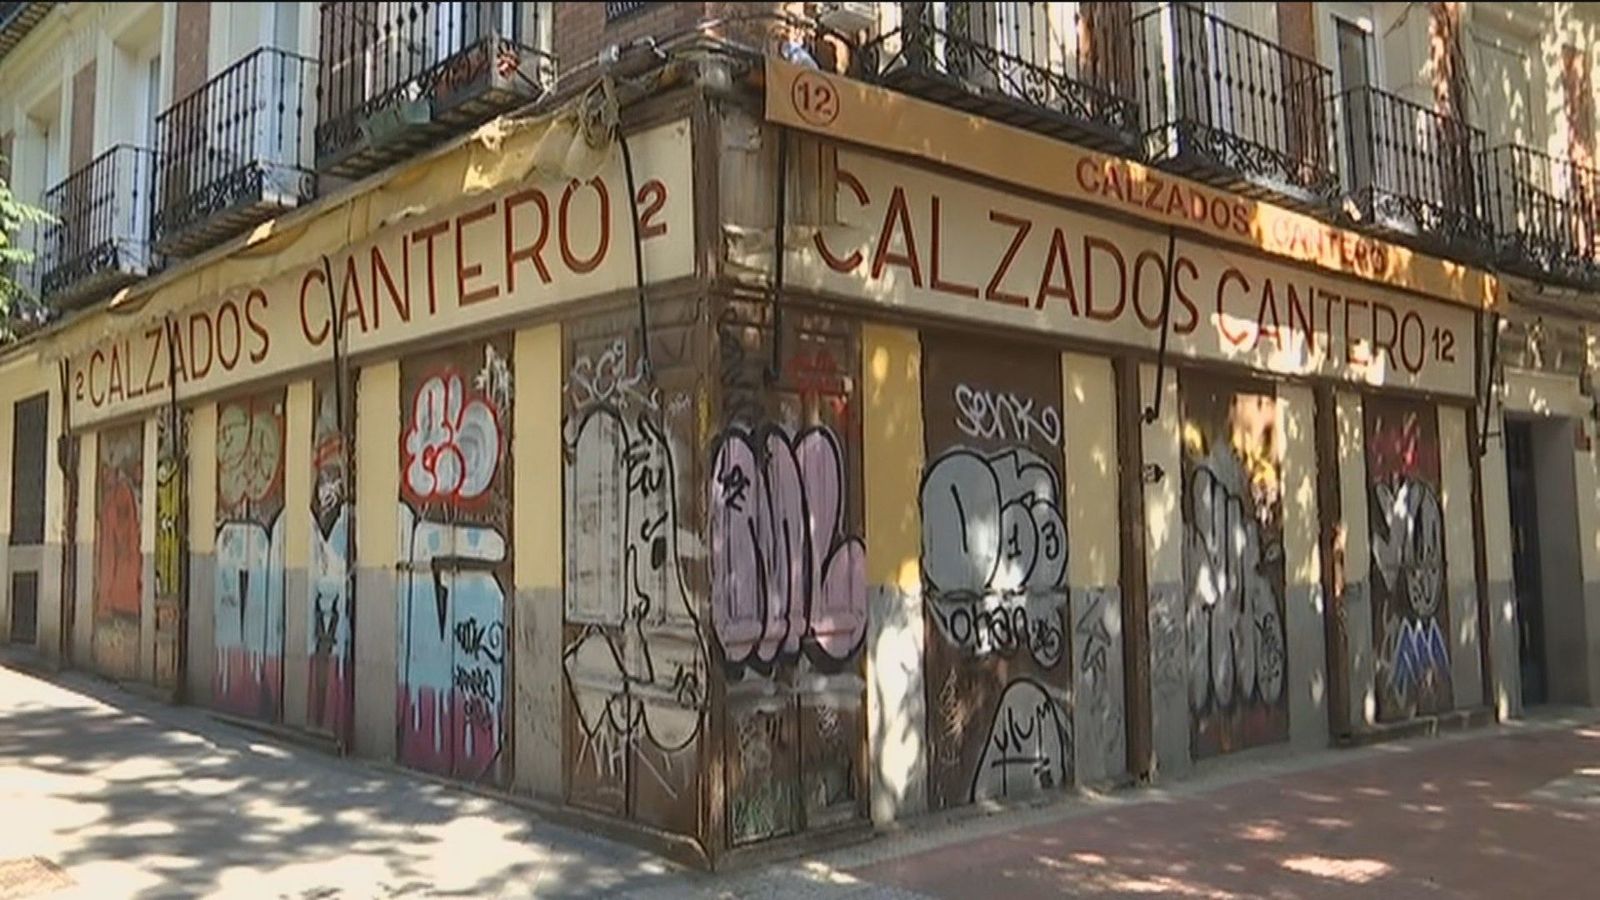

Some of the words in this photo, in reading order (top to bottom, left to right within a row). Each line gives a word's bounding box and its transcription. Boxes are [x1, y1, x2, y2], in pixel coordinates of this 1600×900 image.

[796, 83, 833, 116] 12
[76, 371, 85, 400] 2
[89, 289, 270, 408] CALZADOS
[636, 179, 668, 241] 2
[813, 168, 1200, 335] CALZADOS
[1216, 267, 1426, 375] CANTERO
[1431, 327, 1456, 363] 12
[1076, 156, 1251, 236] CALZADOS
[1273, 216, 1388, 274] CANTERO
